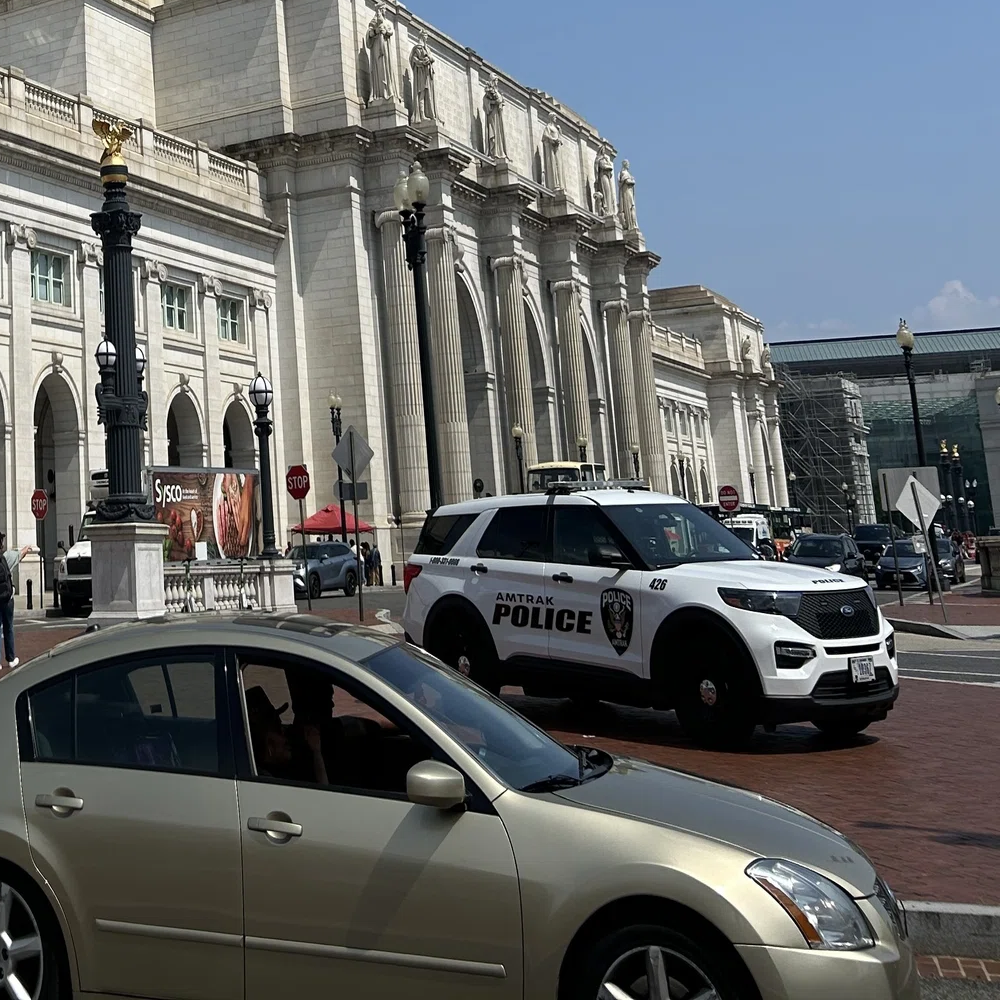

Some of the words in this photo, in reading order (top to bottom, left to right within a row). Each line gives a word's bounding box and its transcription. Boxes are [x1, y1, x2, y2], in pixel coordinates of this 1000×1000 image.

[288, 475, 308, 489] STOP
[155, 479, 182, 508] Sysco
[33, 499, 46, 510] STOP
[649, 578, 668, 591] 426
[496, 592, 554, 606] AMTRAK
[602, 590, 632, 611] POLICE
[492, 603, 593, 634] POLICE
